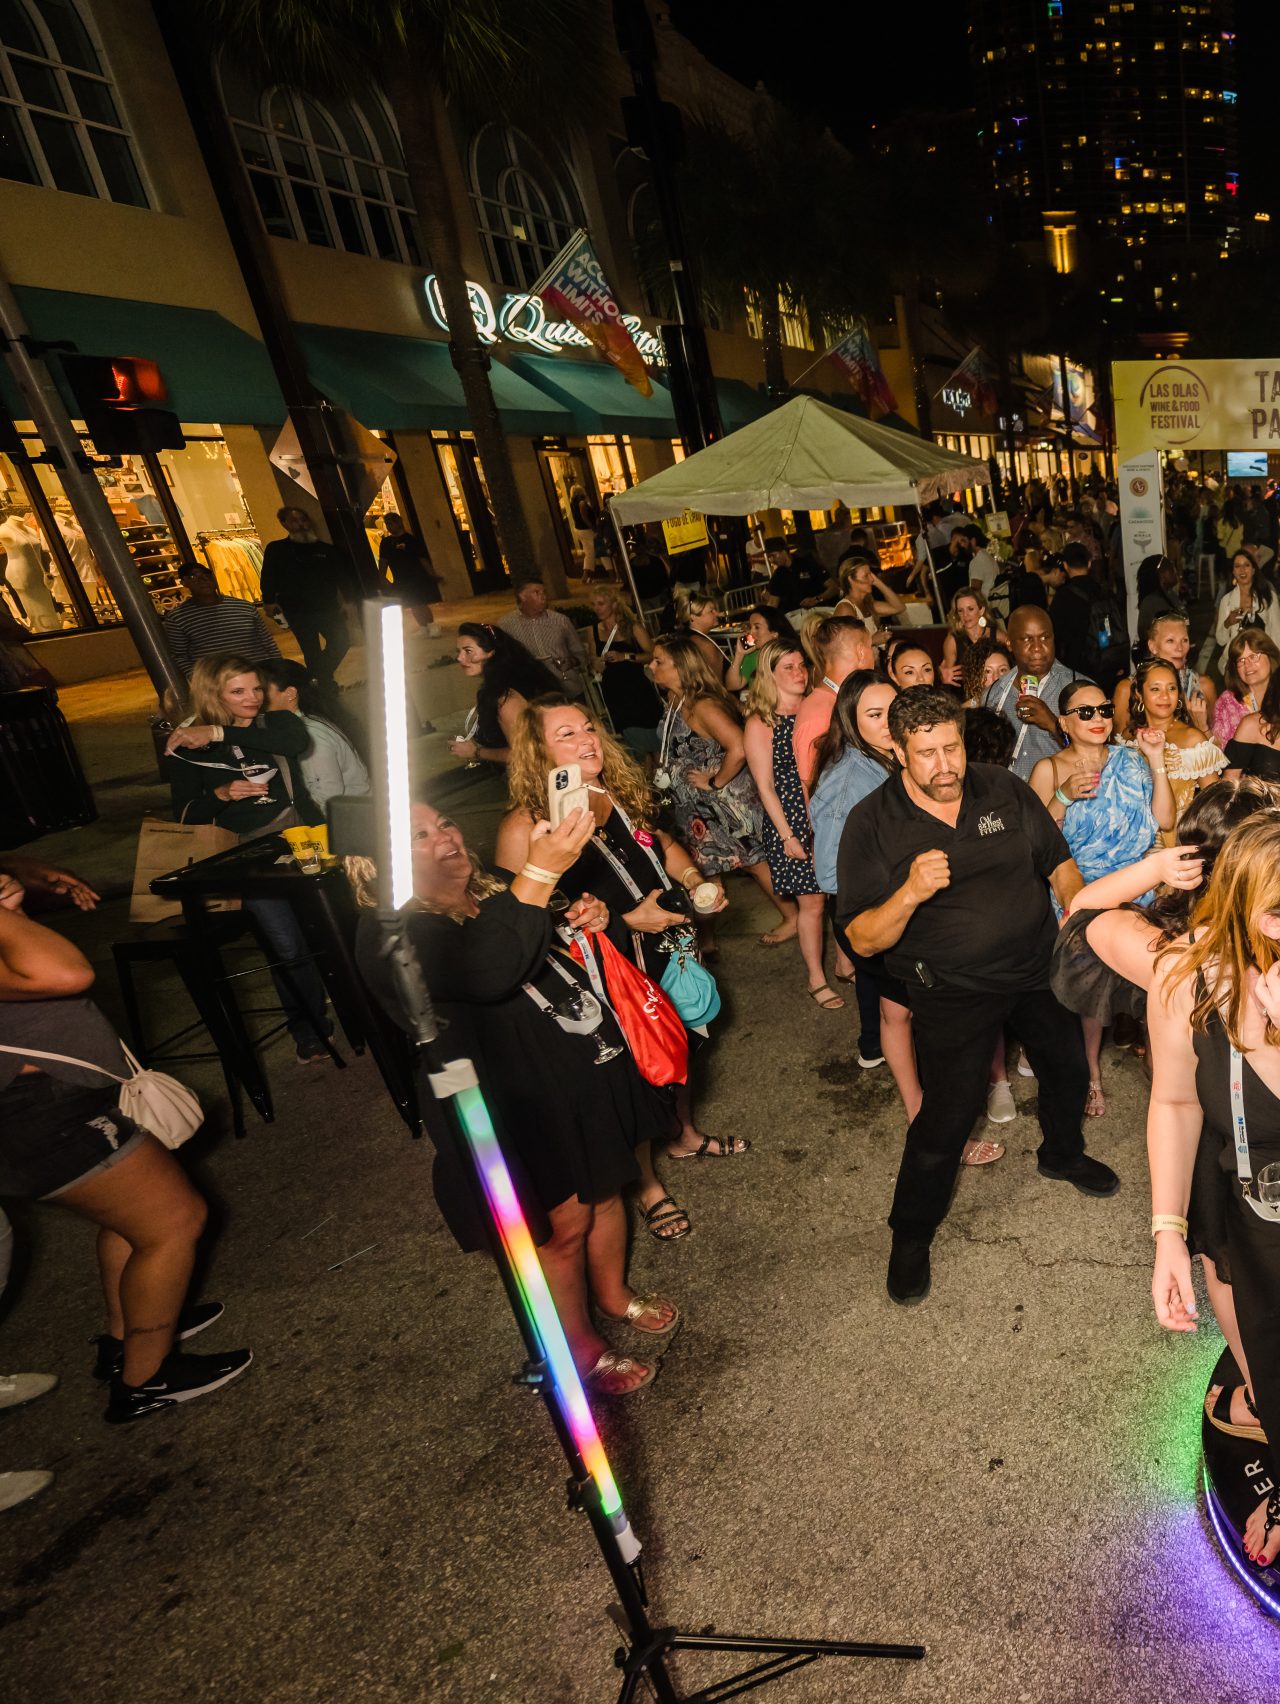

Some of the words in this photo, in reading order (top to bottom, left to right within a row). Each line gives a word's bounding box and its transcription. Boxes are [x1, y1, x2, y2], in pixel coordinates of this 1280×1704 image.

[552, 276, 604, 326] LIMITS
[1150, 383, 1169, 398] LAS
[1172, 383, 1199, 397] OLAS
[1150, 401, 1171, 413] WINE
[1171, 400, 1179, 412] &
[1179, 401, 1200, 412] FOOD
[1151, 415, 1200, 429] FESTIVAL
